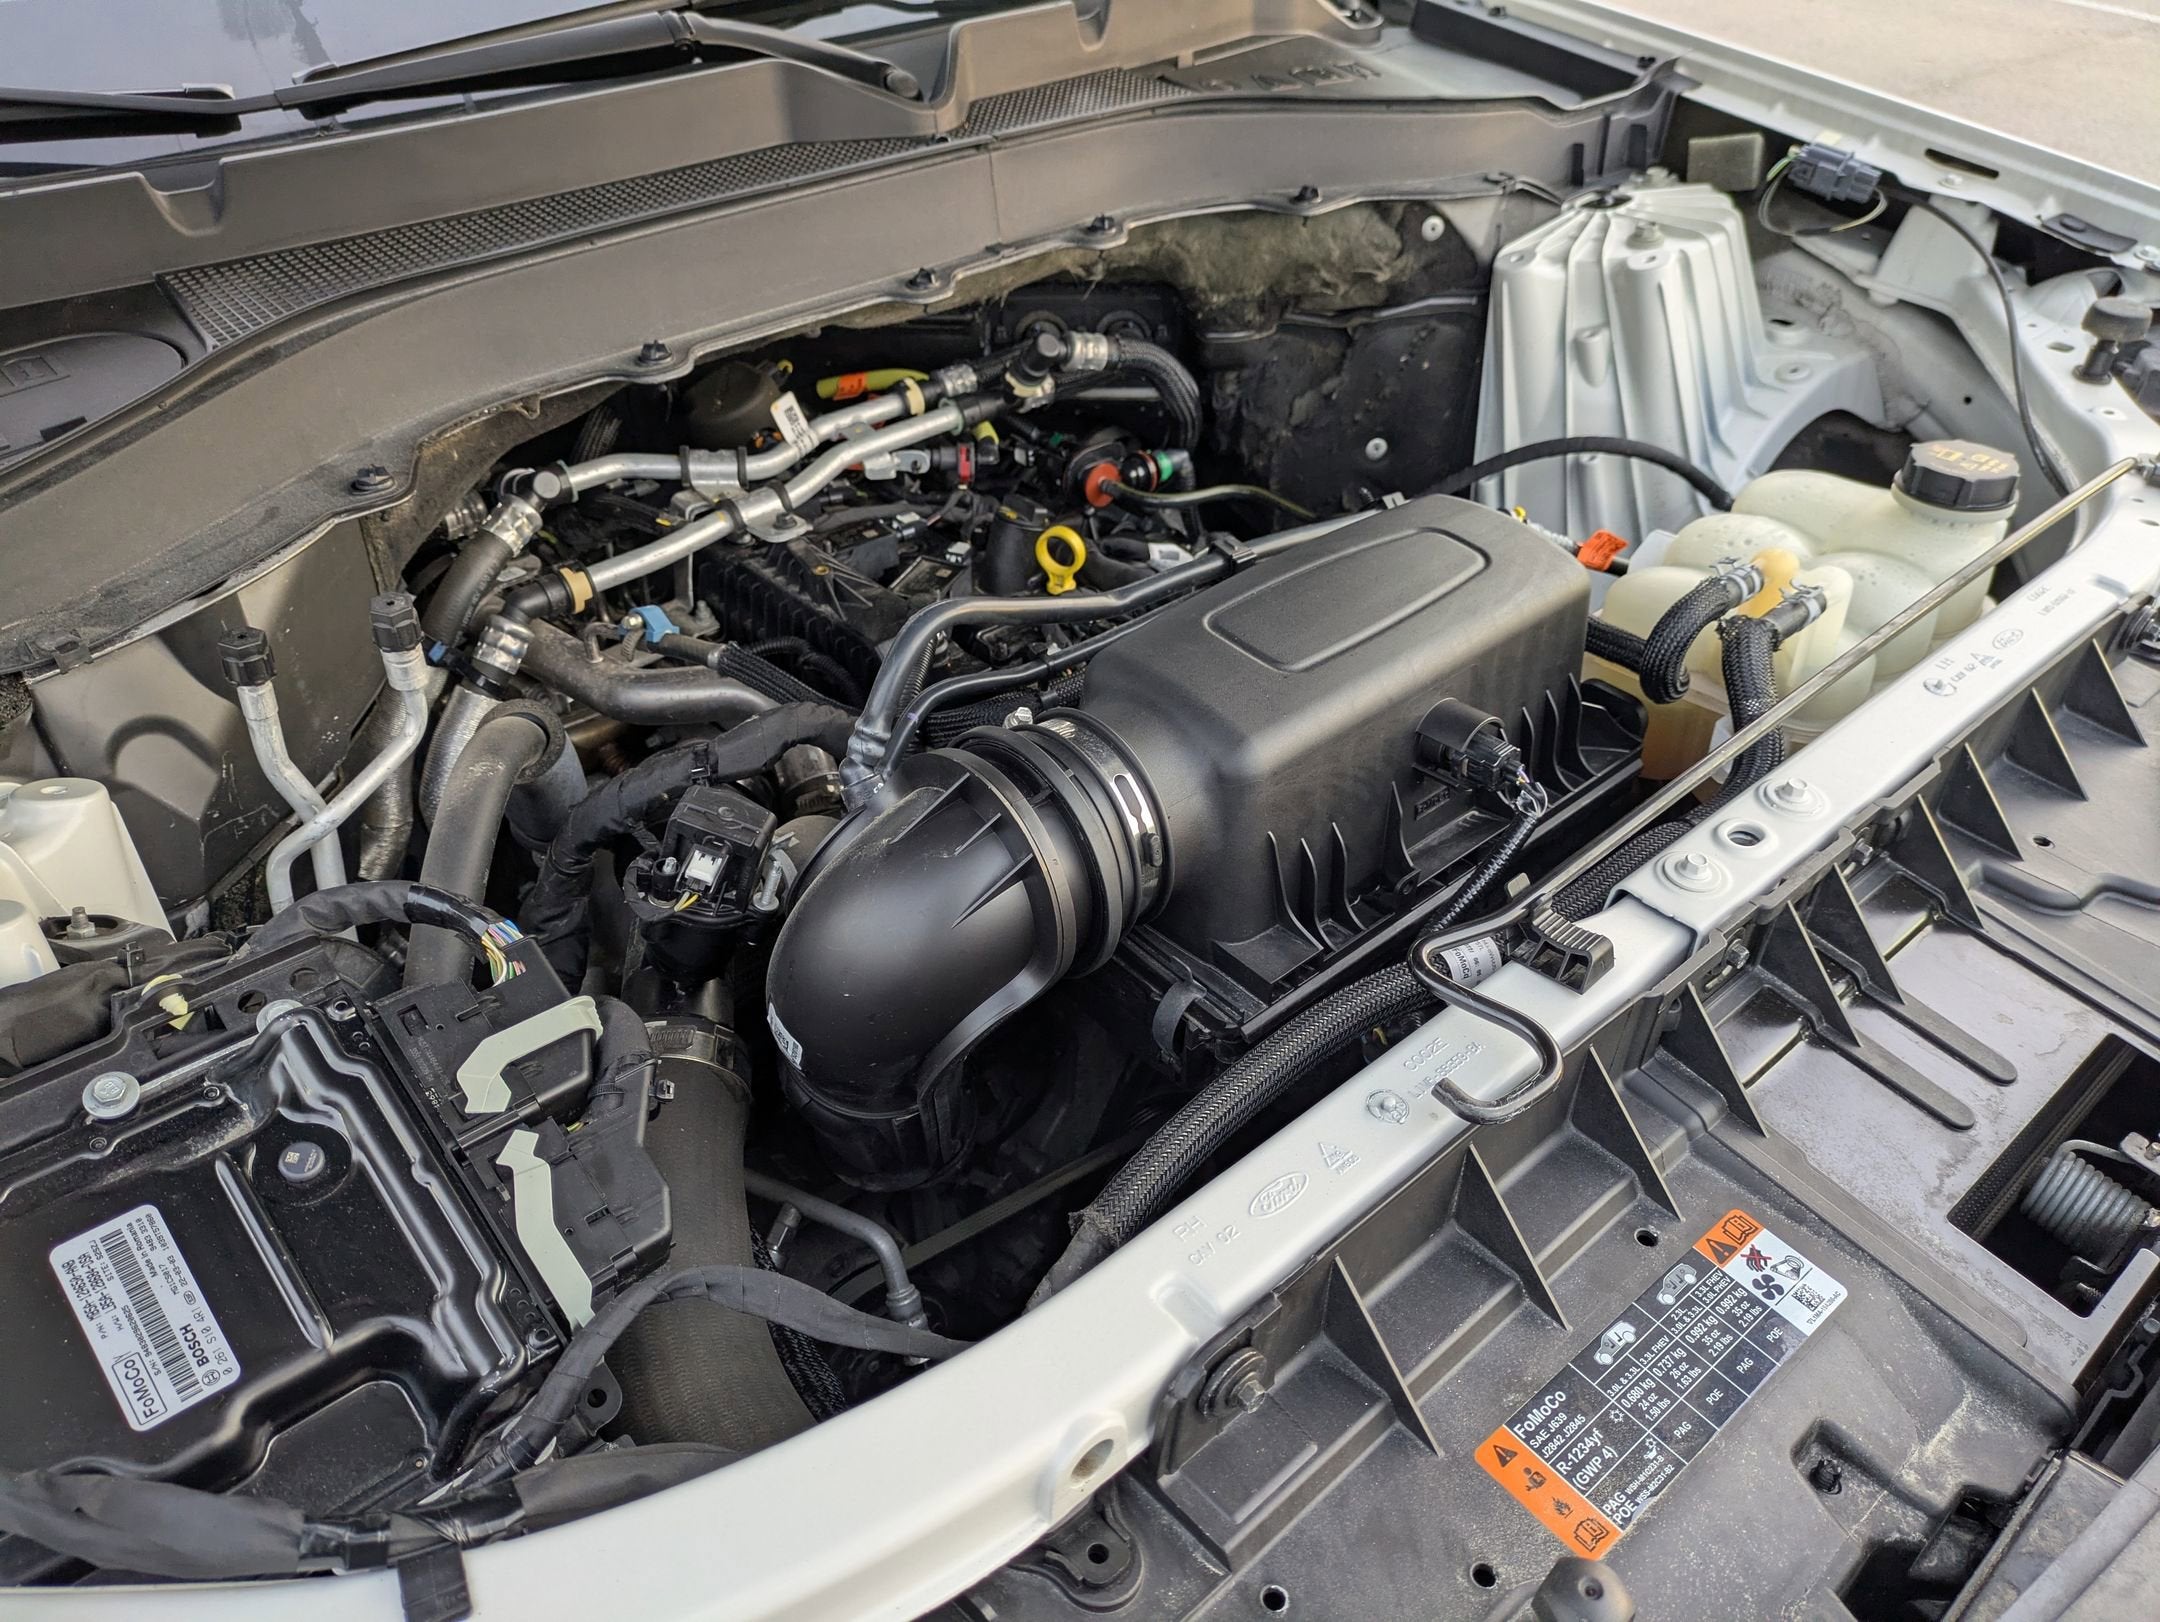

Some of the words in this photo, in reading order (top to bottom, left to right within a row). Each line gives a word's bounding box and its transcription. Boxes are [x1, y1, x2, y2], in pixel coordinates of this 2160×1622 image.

[1453, 947, 1472, 978] FoMoCo
[124, 1221, 144, 1251] Romania
[1173, 1215, 1208, 1243] RH
[99, 1261, 114, 1281] SITE:
[143, 1258, 158, 1278] Made
[1694, 1283, 1710, 1297] 3.3L
[1705, 1269, 1724, 1286] FHEV
[1702, 1289, 1717, 1303] 3.0L
[1713, 1275, 1731, 1292] PHEV
[1714, 1293, 1738, 1315] 0.992
[1731, 1285, 1748, 1300] kg
[1730, 1305, 1744, 1317] 35
[1739, 1300, 1751, 1310] oz
[1670, 1319, 1687, 1334] 3.0L
[1687, 1303, 1703, 1318] 3.3L
[1684, 1321, 1708, 1344] 0.992
[1701, 1313, 1719, 1328] kg
[1737, 1312, 1754, 1327] 2.19
[1748, 1303, 1762, 1316] lbs
[95, 1321, 108, 1339] P/N:
[1700, 1334, 1714, 1346] 35
[1709, 1328, 1721, 1339] oz
[1765, 1326, 1784, 1343] POE
[179, 1322, 209, 1367] BOSCH
[211, 1347, 227, 1364] 261
[1638, 1349, 1655, 1365] 3.3L
[1650, 1334, 1670, 1353] FHEV
[1707, 1341, 1725, 1357] 2.19
[1719, 1332, 1734, 1345] lbs
[148, 1358, 161, 1375] S/N:
[1651, 1354, 1676, 1377] 0.737
[1669, 1345, 1687, 1361] kg
[1668, 1367, 1682, 1379] 26
[1677, 1360, 1690, 1372] oz
[1735, 1356, 1754, 1374] PAG
[119, 1357, 159, 1419] FoMoCo
[1606, 1380, 1623, 1397] 3.0L
[1624, 1363, 1641, 1379] 3.3L
[1675, 1374, 1693, 1390] 1.63
[1687, 1364, 1702, 1378] lbs
[1619, 1385, 1645, 1408] 0.680
[1638, 1375, 1656, 1391] kg
[1637, 1398, 1651, 1411] 24
[1646, 1392, 1658, 1403] oz
[1705, 1387, 1724, 1406] POE
[1511, 1387, 1568, 1439] FoMoCo
[1643, 1405, 1662, 1422] 1.50
[1656, 1395, 1671, 1409] lbs
[1528, 1428, 1551, 1449] SAE
[1545, 1411, 1568, 1432] J639
[1539, 1433, 1566, 1458] J2842
[1560, 1413, 1587, 1438] J2845
[1673, 1420, 1692, 1439] PAG
[1554, 1426, 1607, 1477] R-1234yf
[1570, 1454, 1609, 1492] (GWP
[1598, 1443, 1620, 1463] 4)
[1601, 1490, 1627, 1515] PAG
[1612, 1498, 1638, 1524] POE
